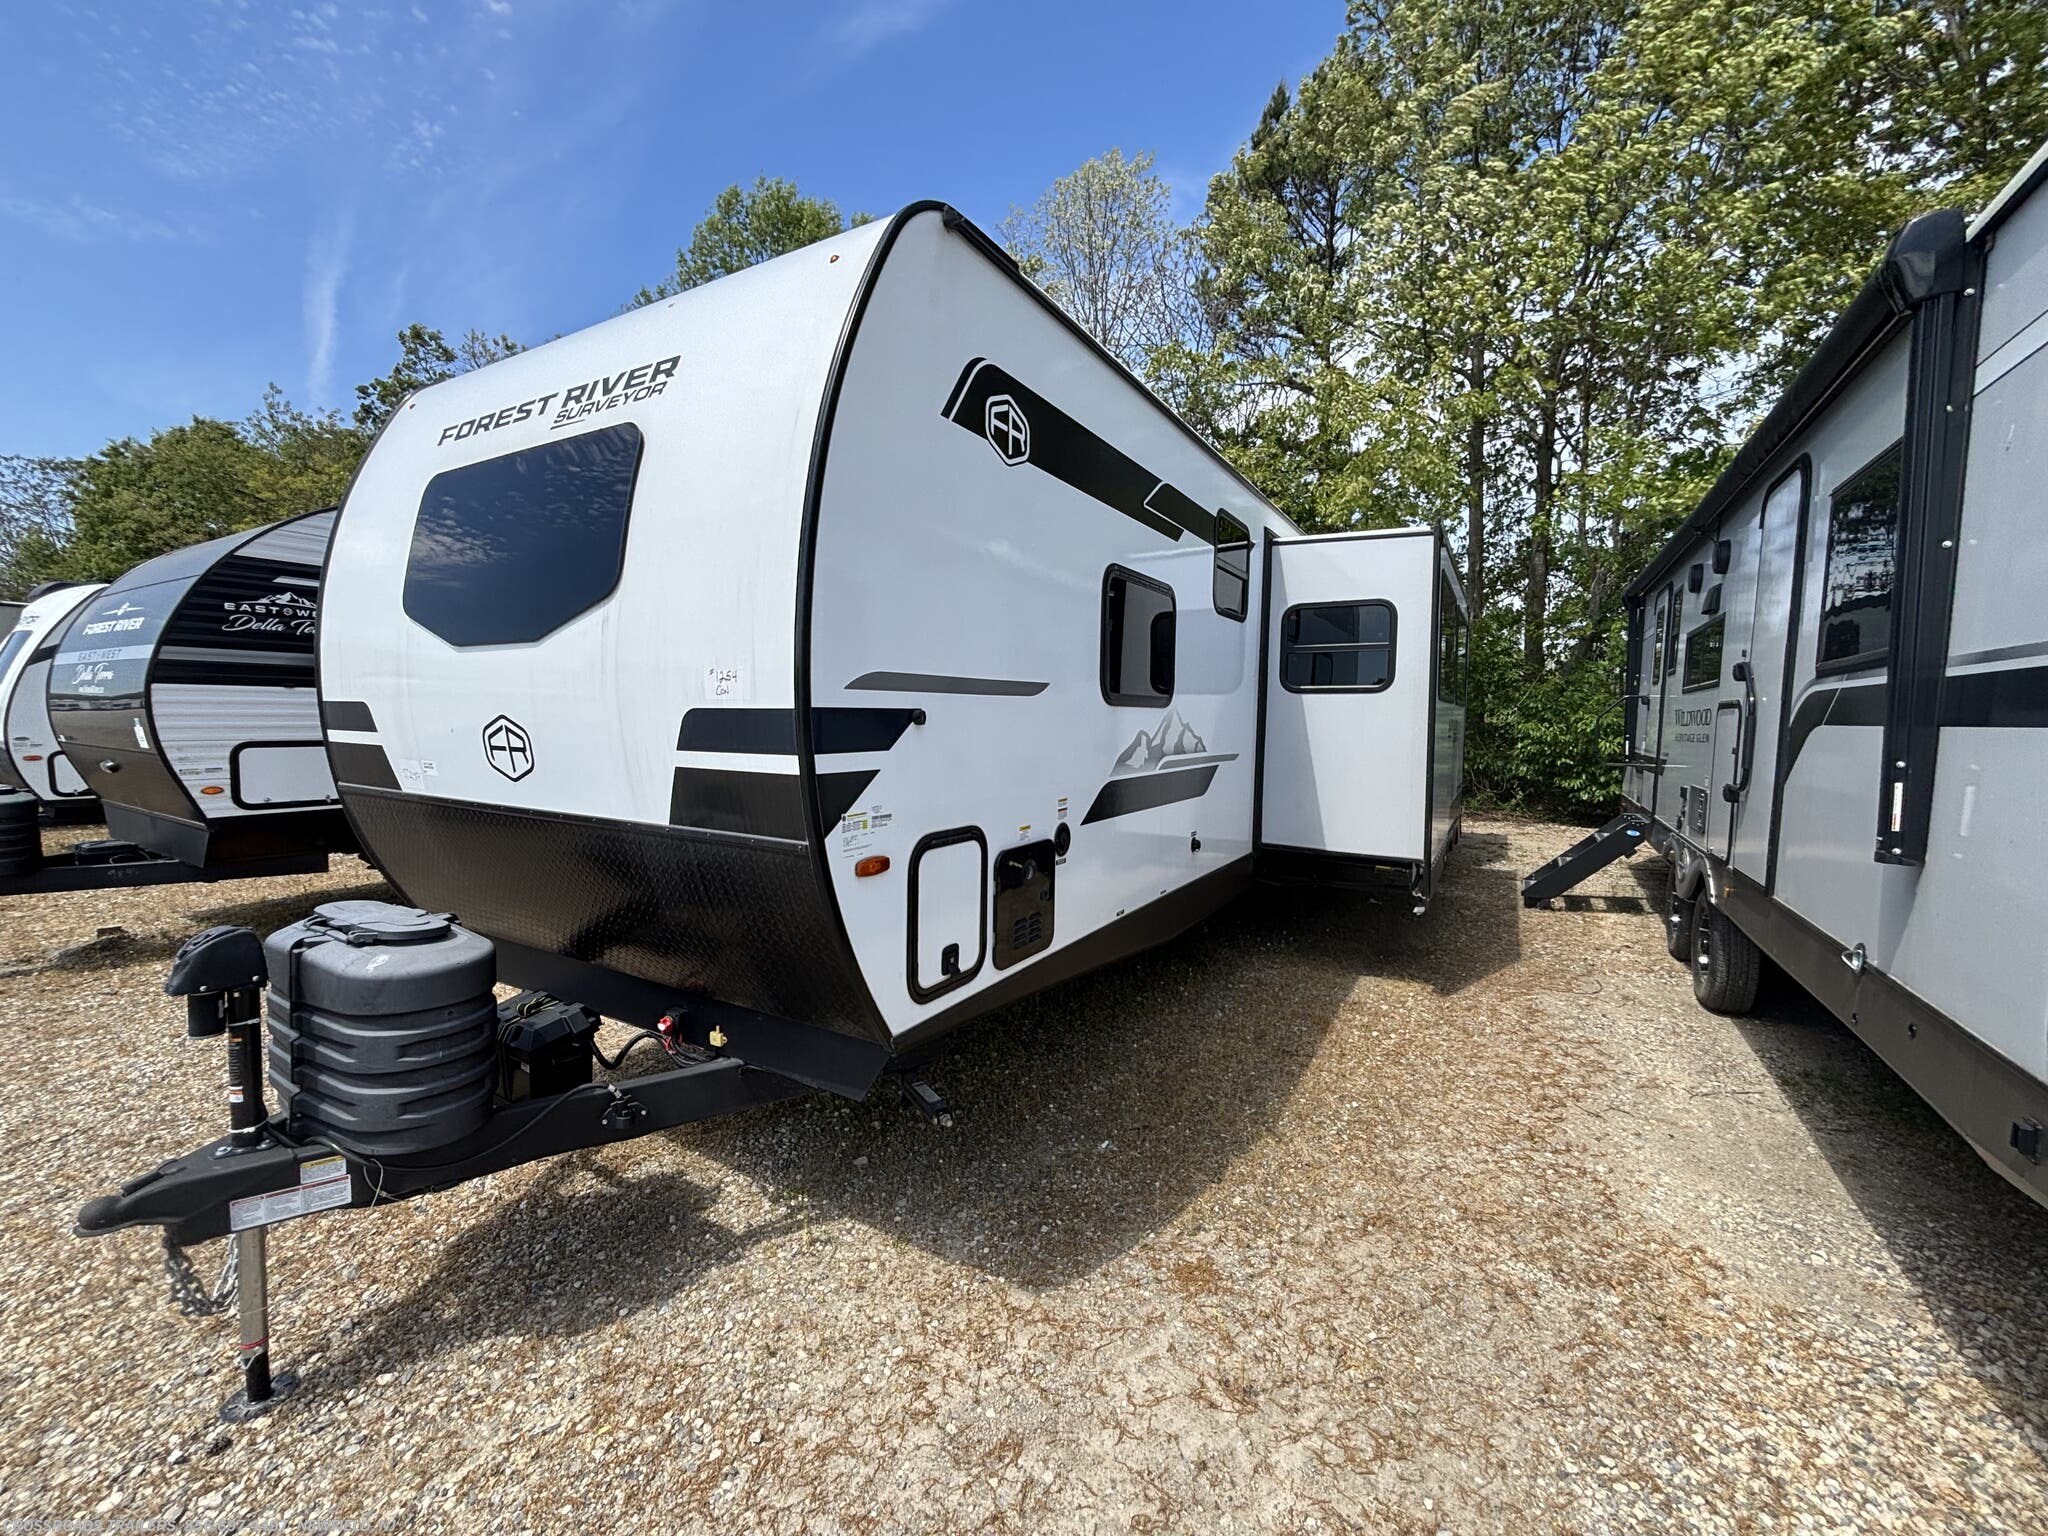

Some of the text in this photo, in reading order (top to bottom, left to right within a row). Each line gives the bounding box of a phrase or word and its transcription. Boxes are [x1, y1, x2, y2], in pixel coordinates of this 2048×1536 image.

[437, 355, 681, 446] FOREST RIVER
[554, 381, 668, 424] SURVEYOR
[223, 602, 280, 614] EAST
[82, 616, 145, 635] FOREST RIVER
[222, 614, 286, 631] Della
